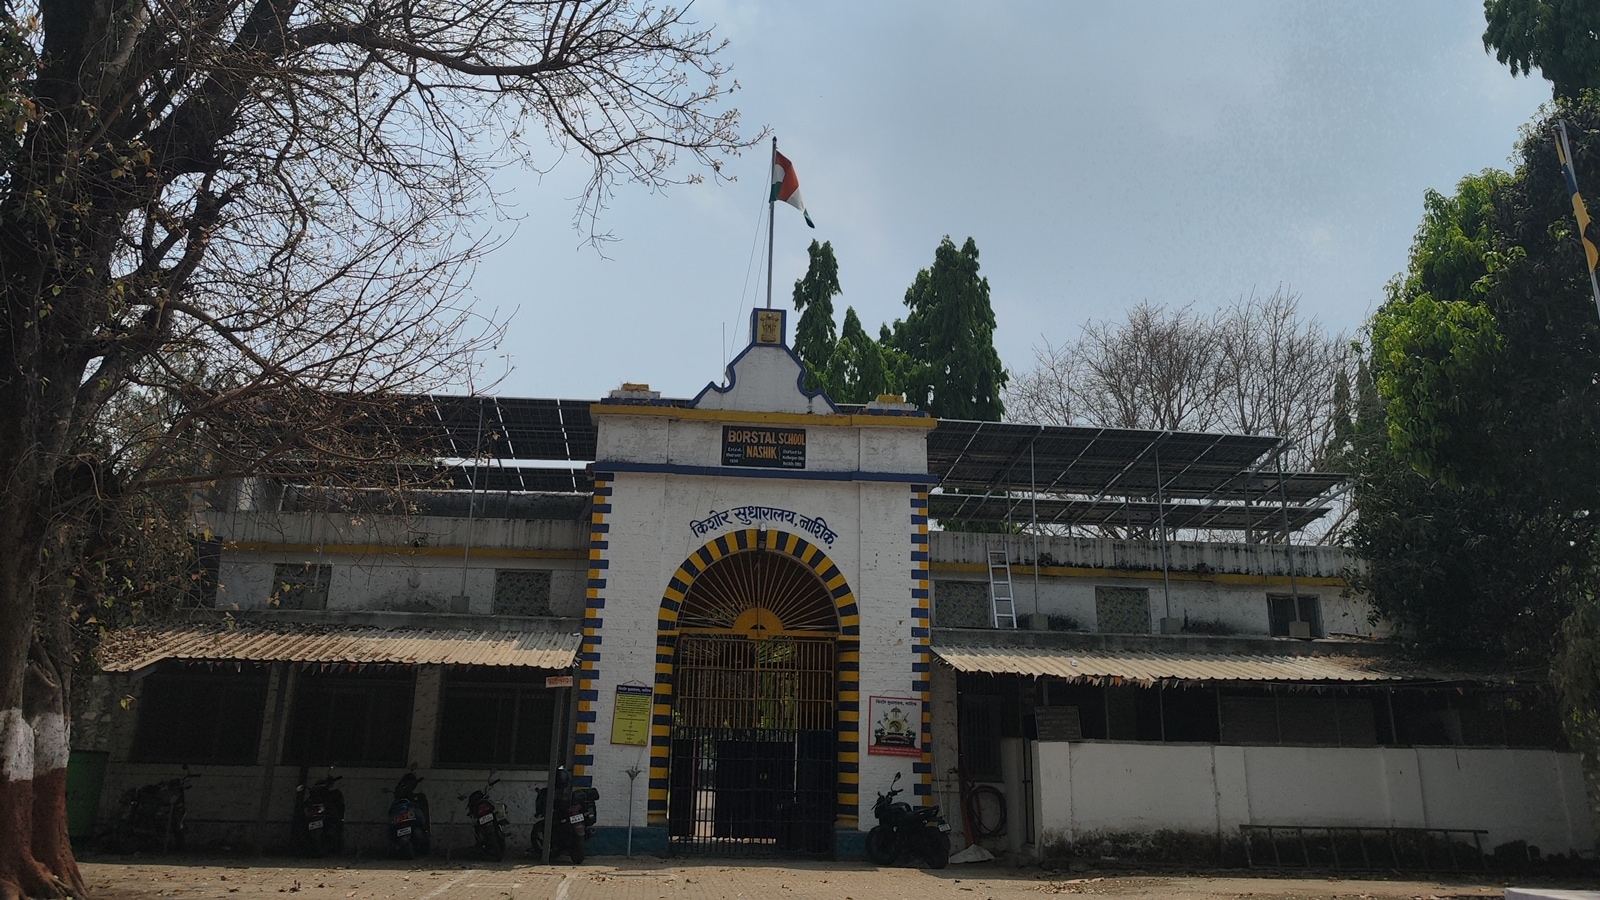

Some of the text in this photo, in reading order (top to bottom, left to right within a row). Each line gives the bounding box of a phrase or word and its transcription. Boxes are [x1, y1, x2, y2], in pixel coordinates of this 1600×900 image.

[728, 430, 806, 446] BORSTAL SCHOOL
[746, 445, 777, 459] NASHIK
[690, 510, 732, 538] किशोर
[731, 506, 798, 527] सुधारालय,
